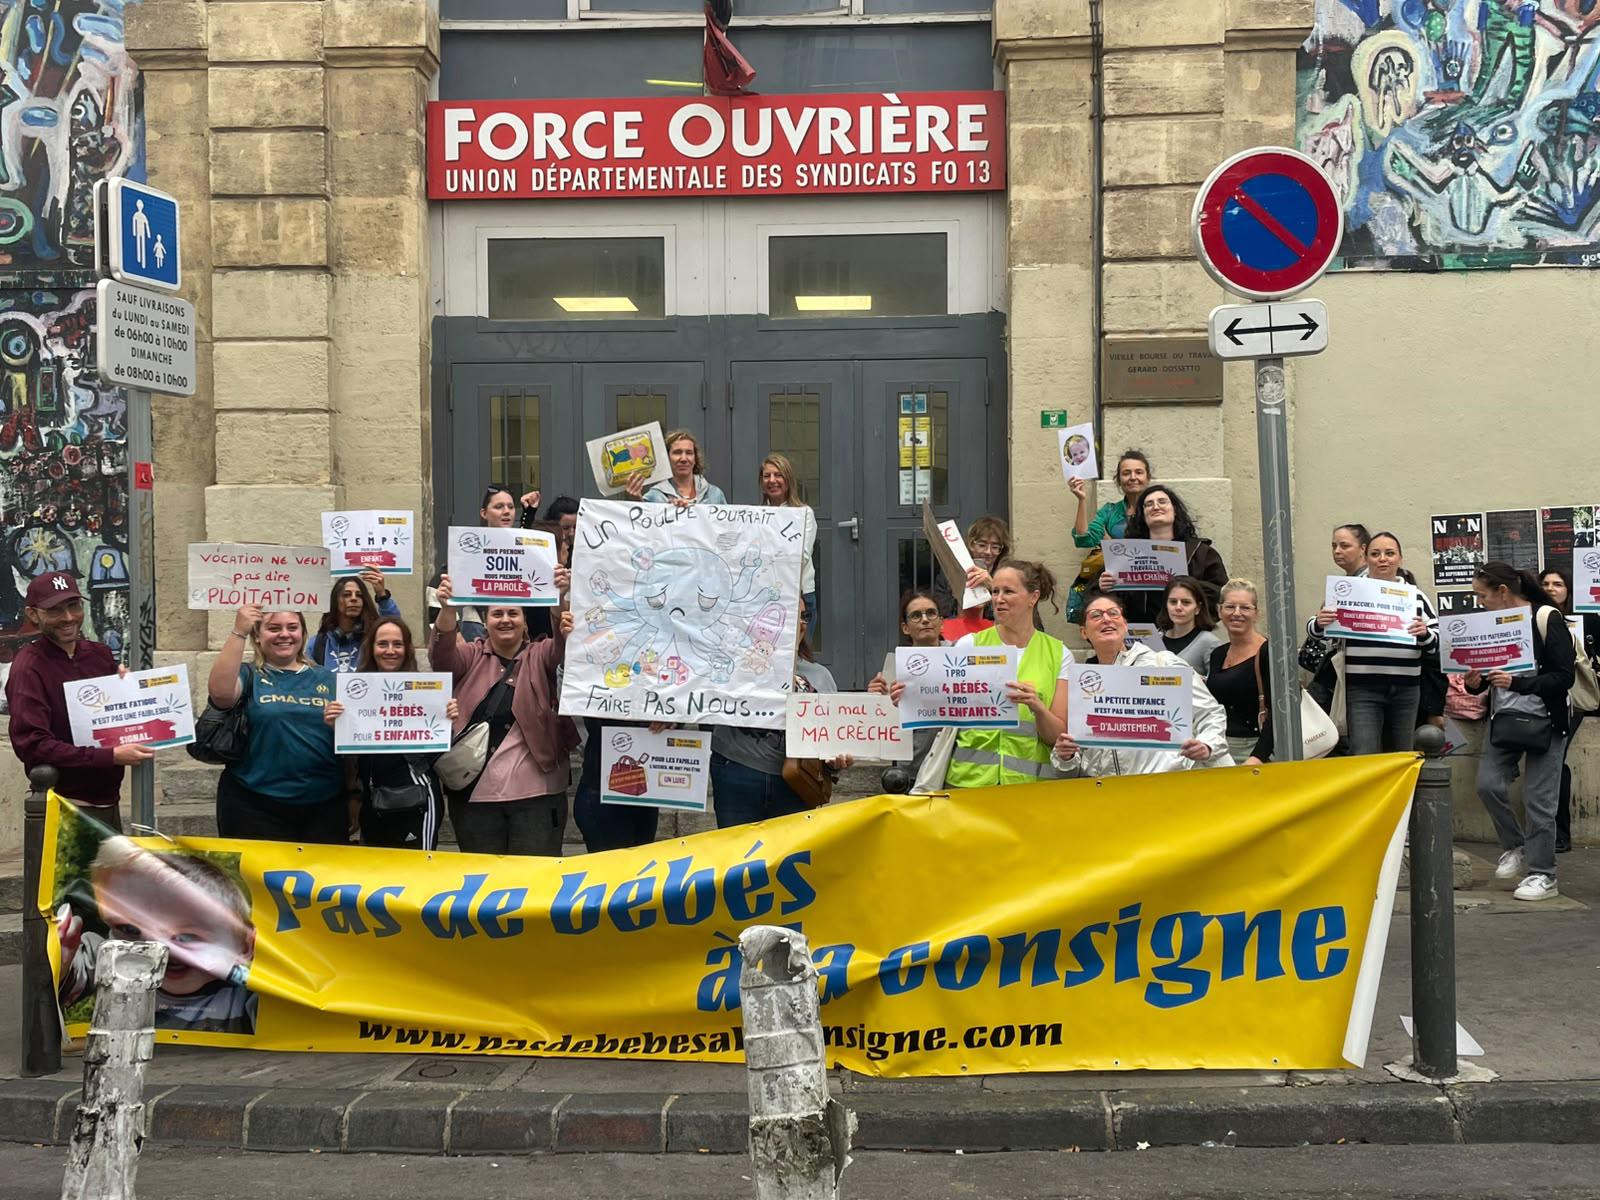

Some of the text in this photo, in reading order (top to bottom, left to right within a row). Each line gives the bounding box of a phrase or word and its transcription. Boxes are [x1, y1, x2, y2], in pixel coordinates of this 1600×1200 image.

[444, 92, 989, 162] FORCE OUVRIÈRE
[445, 160, 991, 194] UNION DÉPARTEMENTALE DES SYNDICATS FO 13
[116, 291, 185, 317] SAUF LIVRAISONS
[112, 308, 190, 335] du LUNDI au SAMEDI
[114, 325, 188, 351] de 06h00 à 10h00
[131, 347, 172, 365] DIMANCHE
[1140, 352, 1168, 360] BOURSE
[1188, 351, 1214, 359] TRAVA
[114, 364, 188, 388] de 08h00 à 10h00
[780, 520, 802, 542] LE
[271, 556, 288, 565] NE
[295, 556, 327, 565] VEUT
[486, 556, 523, 571] SOIN.
[233, 570, 290, 584] pas dire
[482, 582, 526, 592] LA PAROLE.
[945, 669, 966, 677] 1 PRO
[920, 680, 992, 694] POUR 4 BÉBÉS.
[383, 693, 403, 701] 1 PRO
[947, 696, 968, 704] 1 PRO
[1094, 696, 1166, 706] LA PETITE ENFANCE
[104, 697, 157, 712] NOTRE FATIGUE
[358, 703, 427, 717] POUR 4 BÉBÉS.
[796, 699, 887, 718] J'ai mal à
[918, 706, 1001, 717] POUR 5 ENFANTS.
[111, 714, 123, 723] PAS
[388, 719, 403, 727] PRO
[801, 720, 901, 742] MA CRÈCHE
[1100, 722, 1159, 733] D'AJUSTEMENT.
[119, 732, 153, 745] SIGNAL.
[353, 730, 434, 741] POUR 5 ENFANTS.
[262, 839, 818, 940] Pas de bébés
[696, 931, 744, 1012] à
[878, 902, 1350, 1009] consigne
